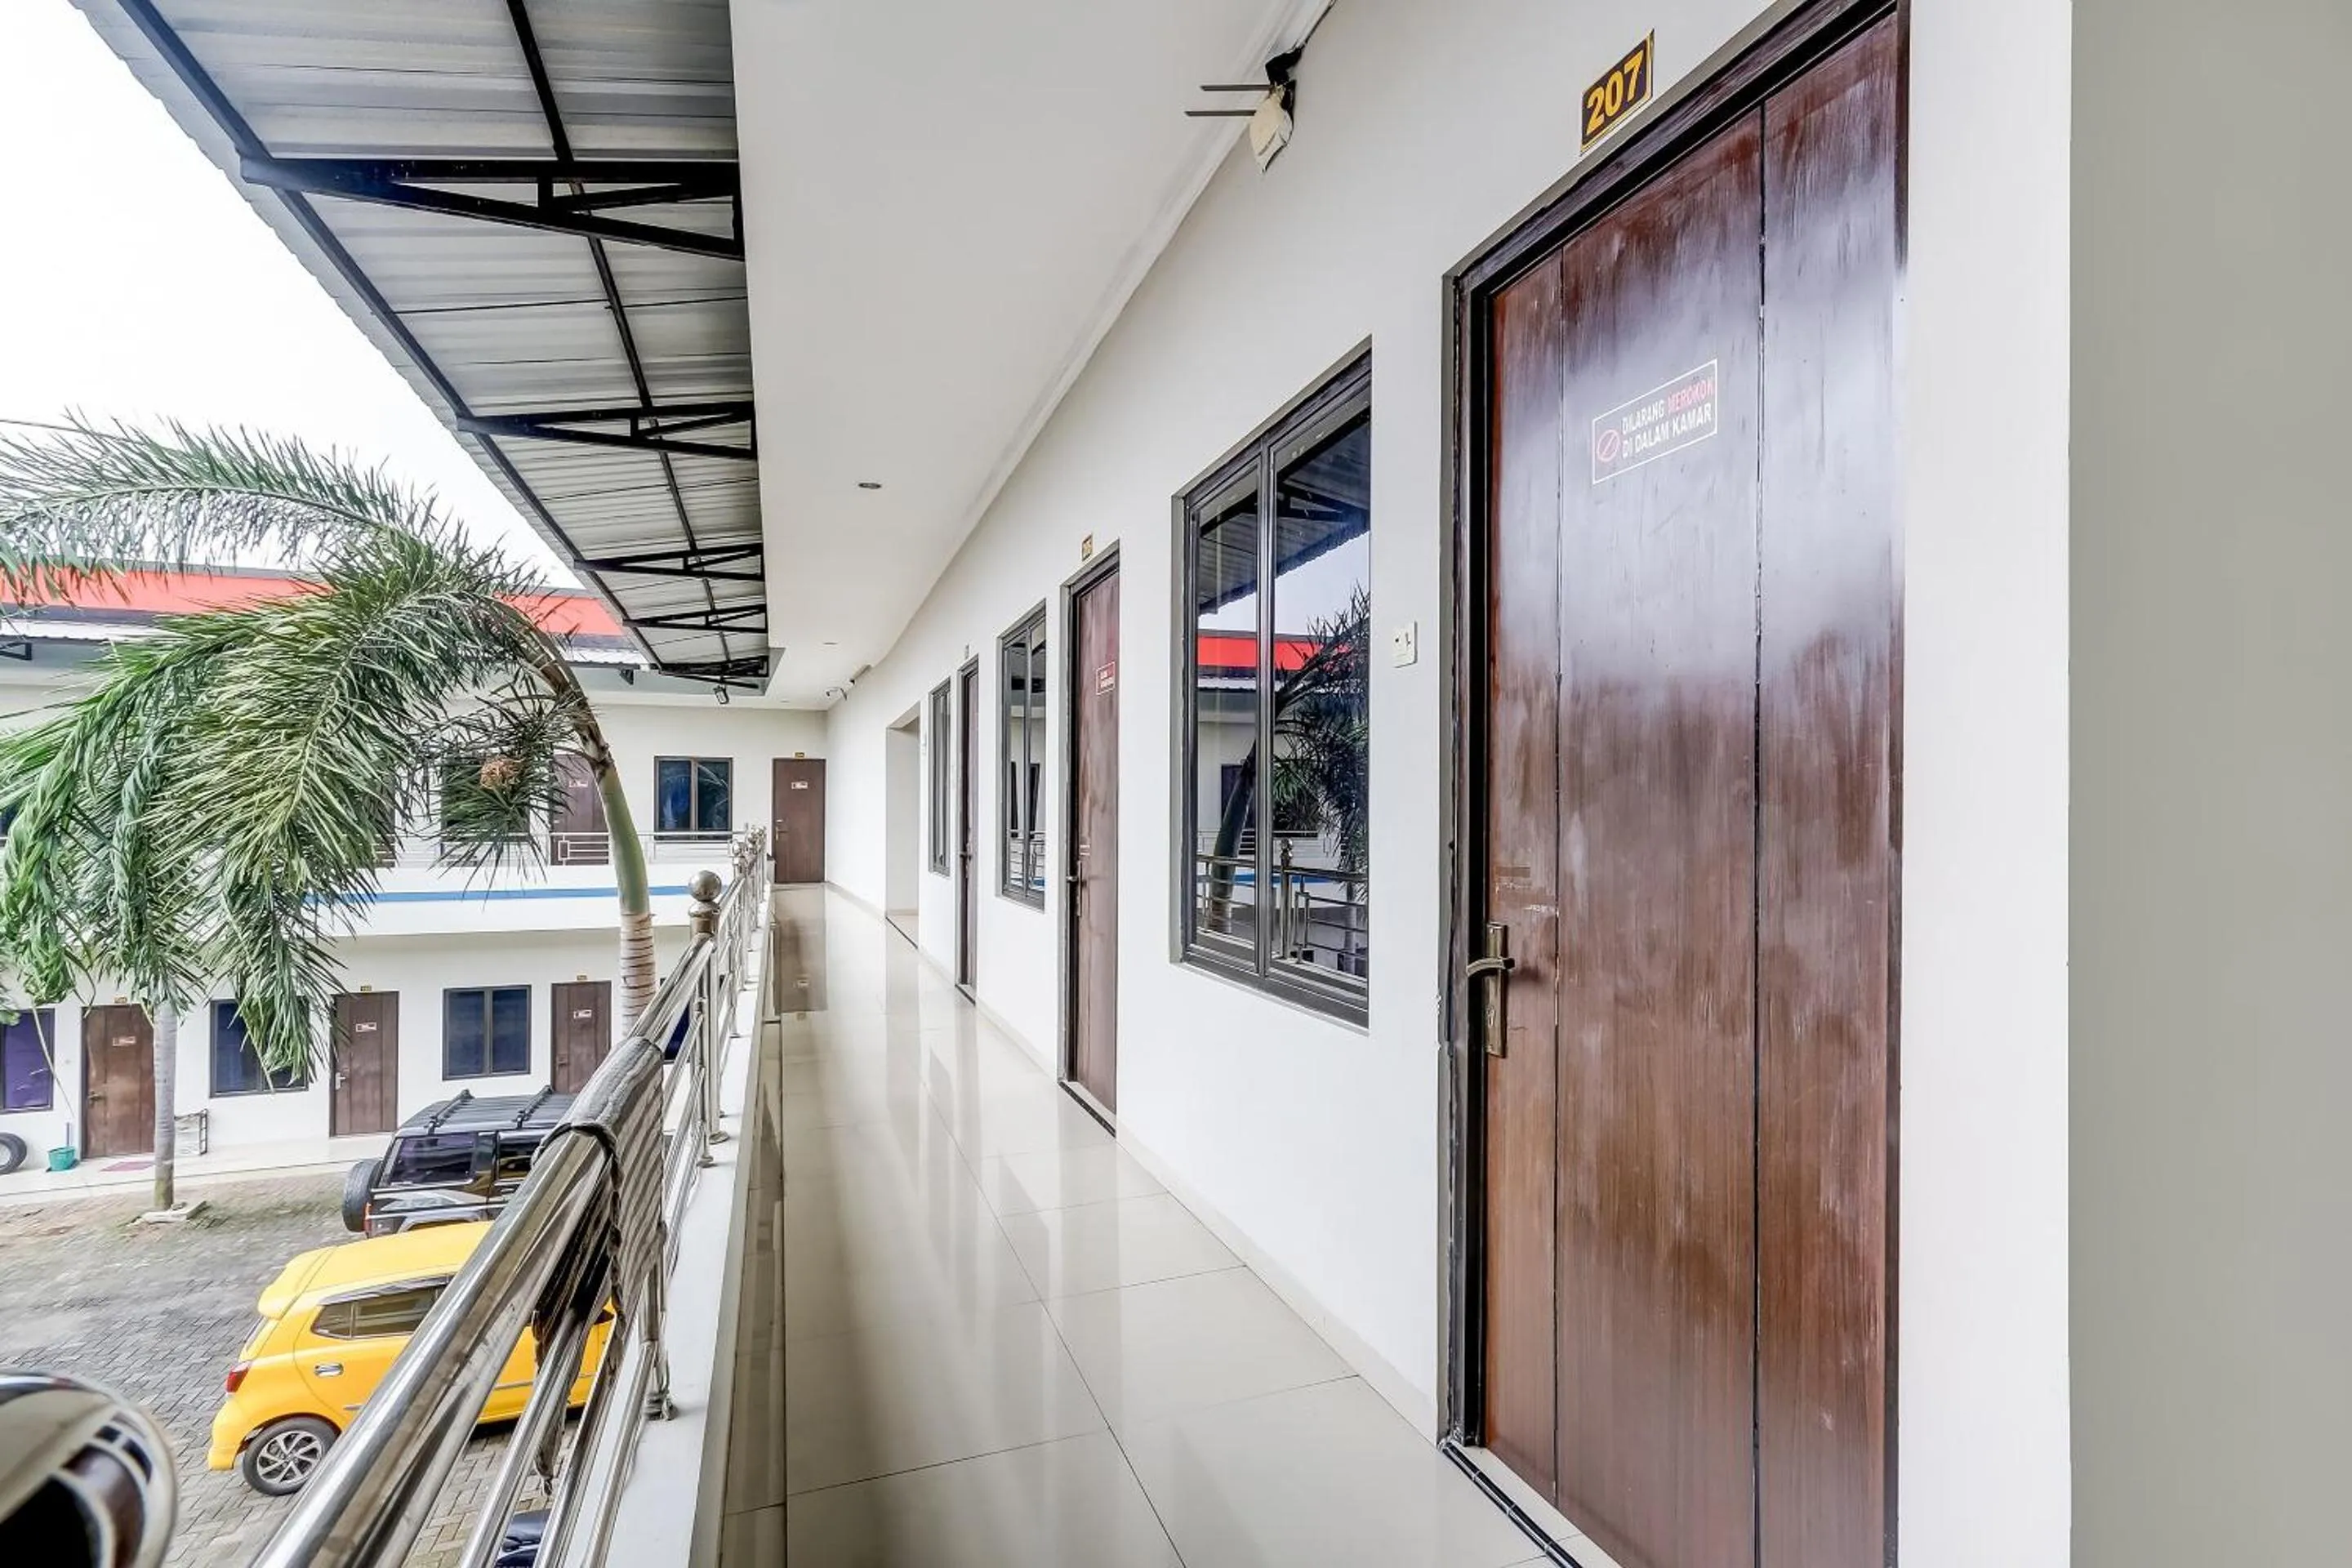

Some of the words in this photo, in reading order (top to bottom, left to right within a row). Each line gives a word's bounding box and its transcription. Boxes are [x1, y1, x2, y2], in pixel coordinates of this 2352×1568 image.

[1586, 50, 1644, 136] 207
[1622, 400, 1665, 435] DILARANG
[1622, 437, 1633, 459] DI
[1635, 422, 1669, 453] DALAM
[1673, 403, 1712, 437] KAMAR
